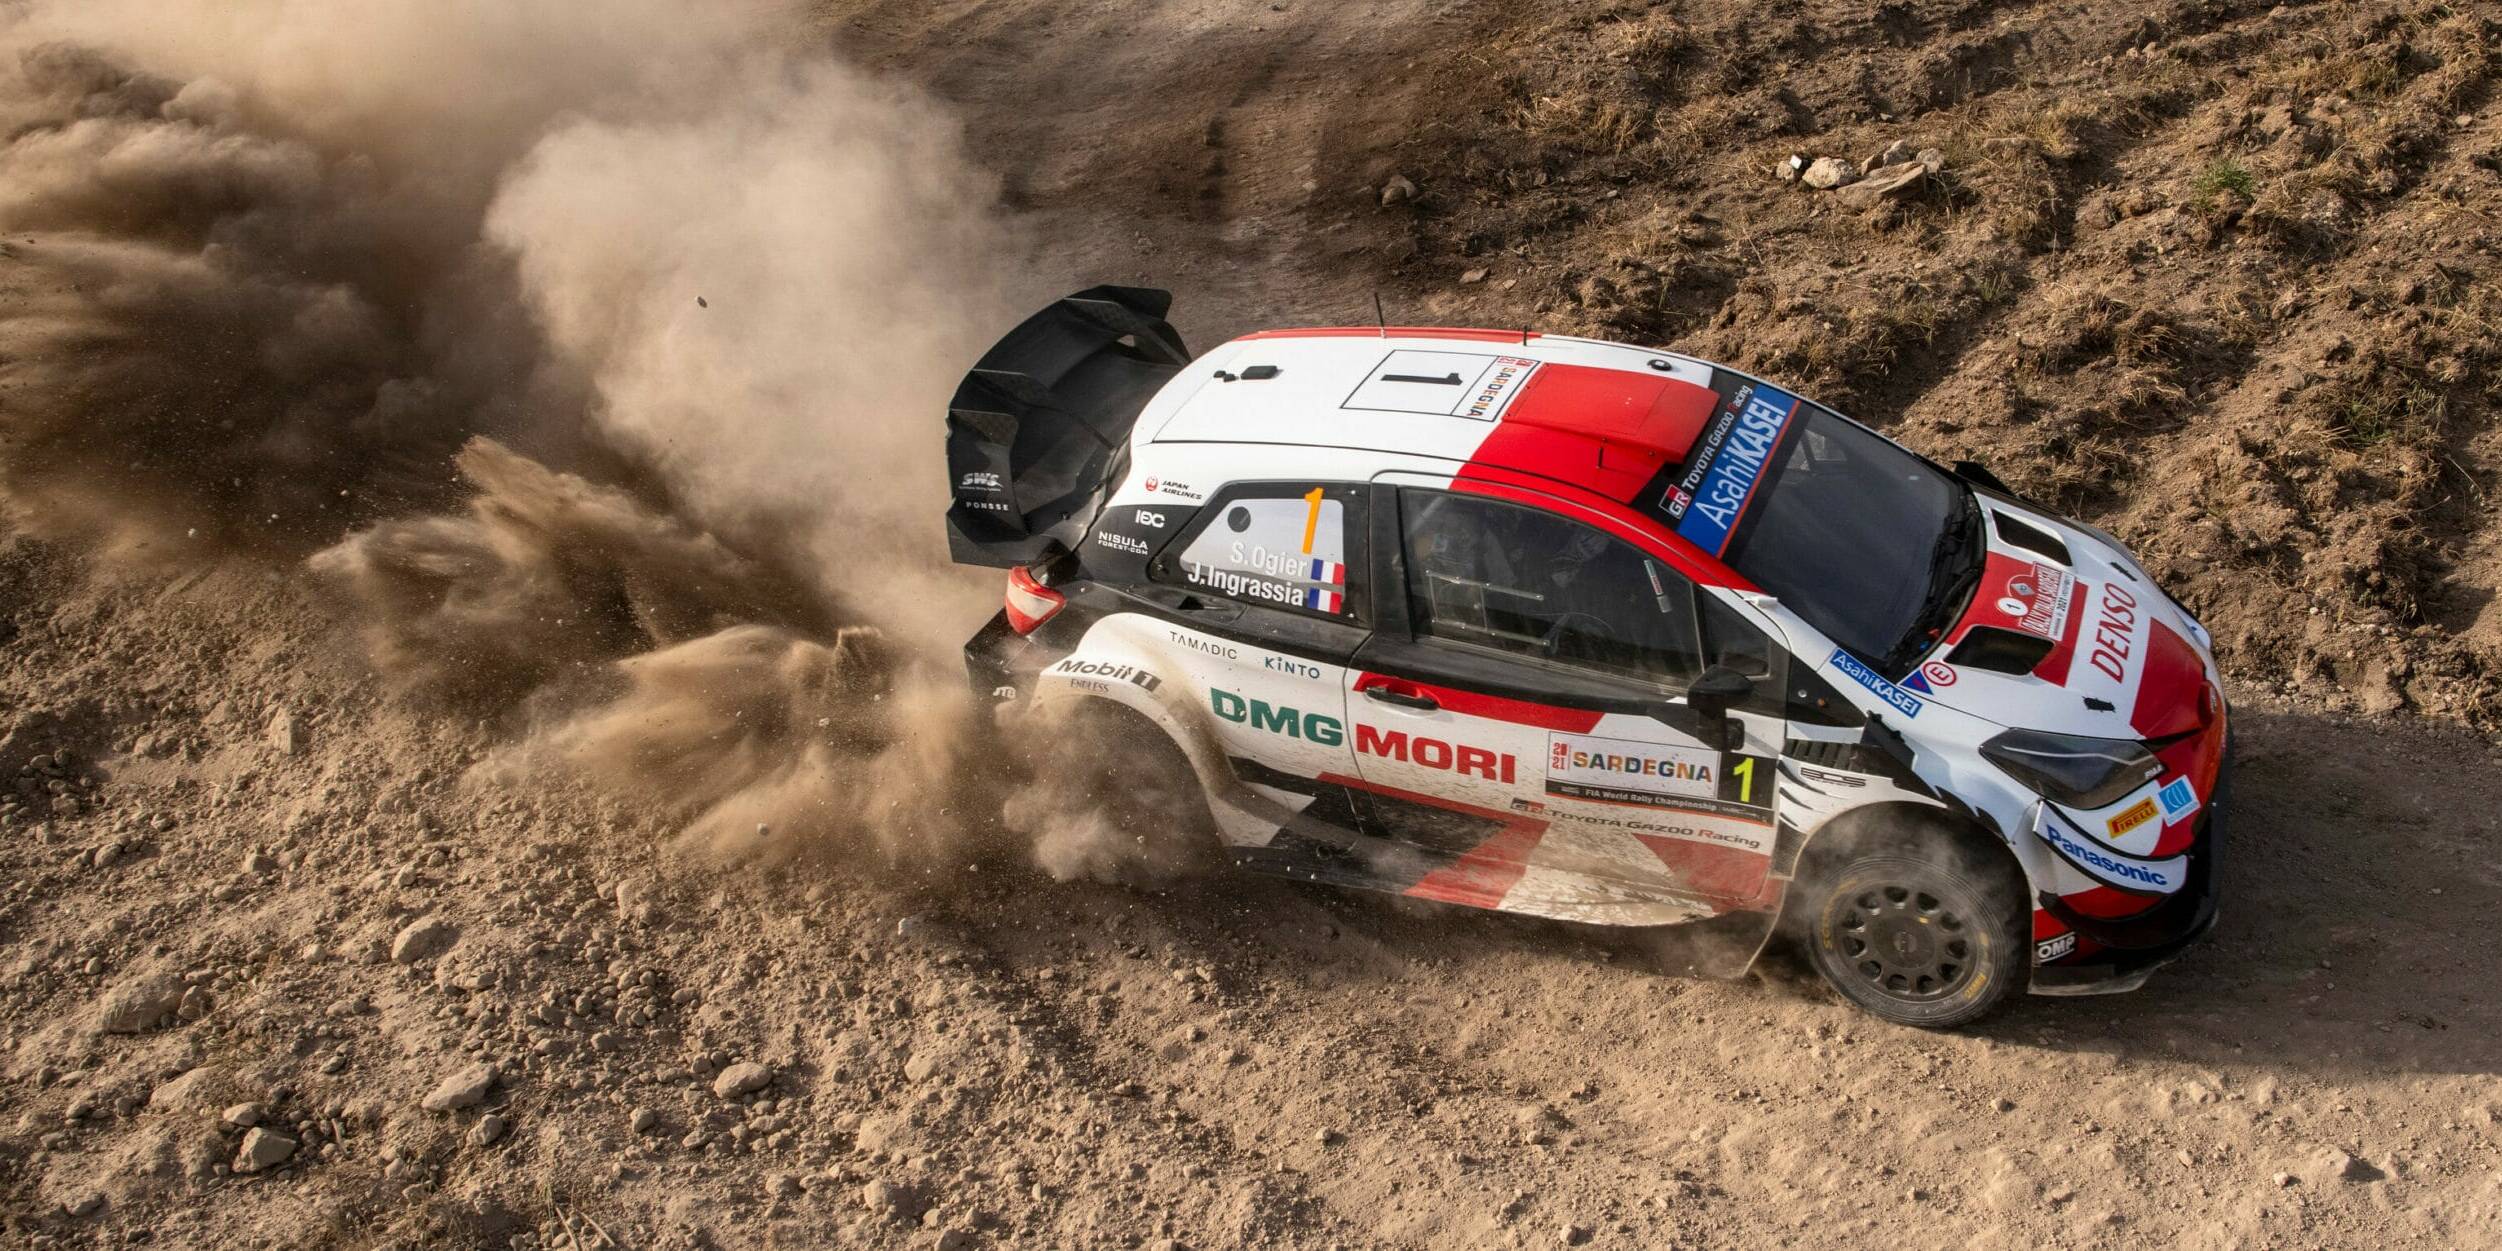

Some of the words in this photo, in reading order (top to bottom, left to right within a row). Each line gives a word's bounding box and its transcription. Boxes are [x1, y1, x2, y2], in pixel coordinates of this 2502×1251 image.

[1380, 372, 1463, 386] 1
[1467, 366, 1517, 417] SARDEGNA
[1668, 491, 1691, 516] GR
[1681, 446, 1715, 491] TOYOTA
[1707, 412, 1736, 448] GAZOO
[1727, 384, 1753, 411] Racing
[1695, 397, 1787, 530] AsahiKASEI
[1161, 479, 1190, 491] JAPAN
[1161, 487, 1203, 500] AIRLINES
[965, 501, 1009, 511] PONSSE
[1302, 486, 1324, 555] 1
[1099, 531, 1149, 550] NISULA
[1169, 631, 1238, 660] TAMADIC
[2090, 582, 2137, 685] DENSO
[1057, 660, 1134, 680] Mobil
[1070, 678, 1110, 694] ENDLESS
[1833, 654, 1920, 715] AsahiKASEI
[1929, 666, 1950, 682] E
[1210, 687, 1343, 747] DMG
[1356, 723, 1516, 785] MORI
[1573, 751, 1713, 783] SARDEGNA
[1732, 757, 1755, 803] 1
[1585, 789, 1601, 797] FIA
[1603, 791, 1629, 801] World
[1631, 794, 1655, 804] Rally
[1655, 796, 1718, 812] Championship
[1550, 809, 1621, 828] TOYOTA
[1627, 821, 1694, 836] GAZOO
[1698, 828, 1761, 849] Racing
[2110, 800, 2156, 834] PIRELLI
[2046, 823, 2168, 886] Panasonic
[2038, 935, 2076, 959] OMP
